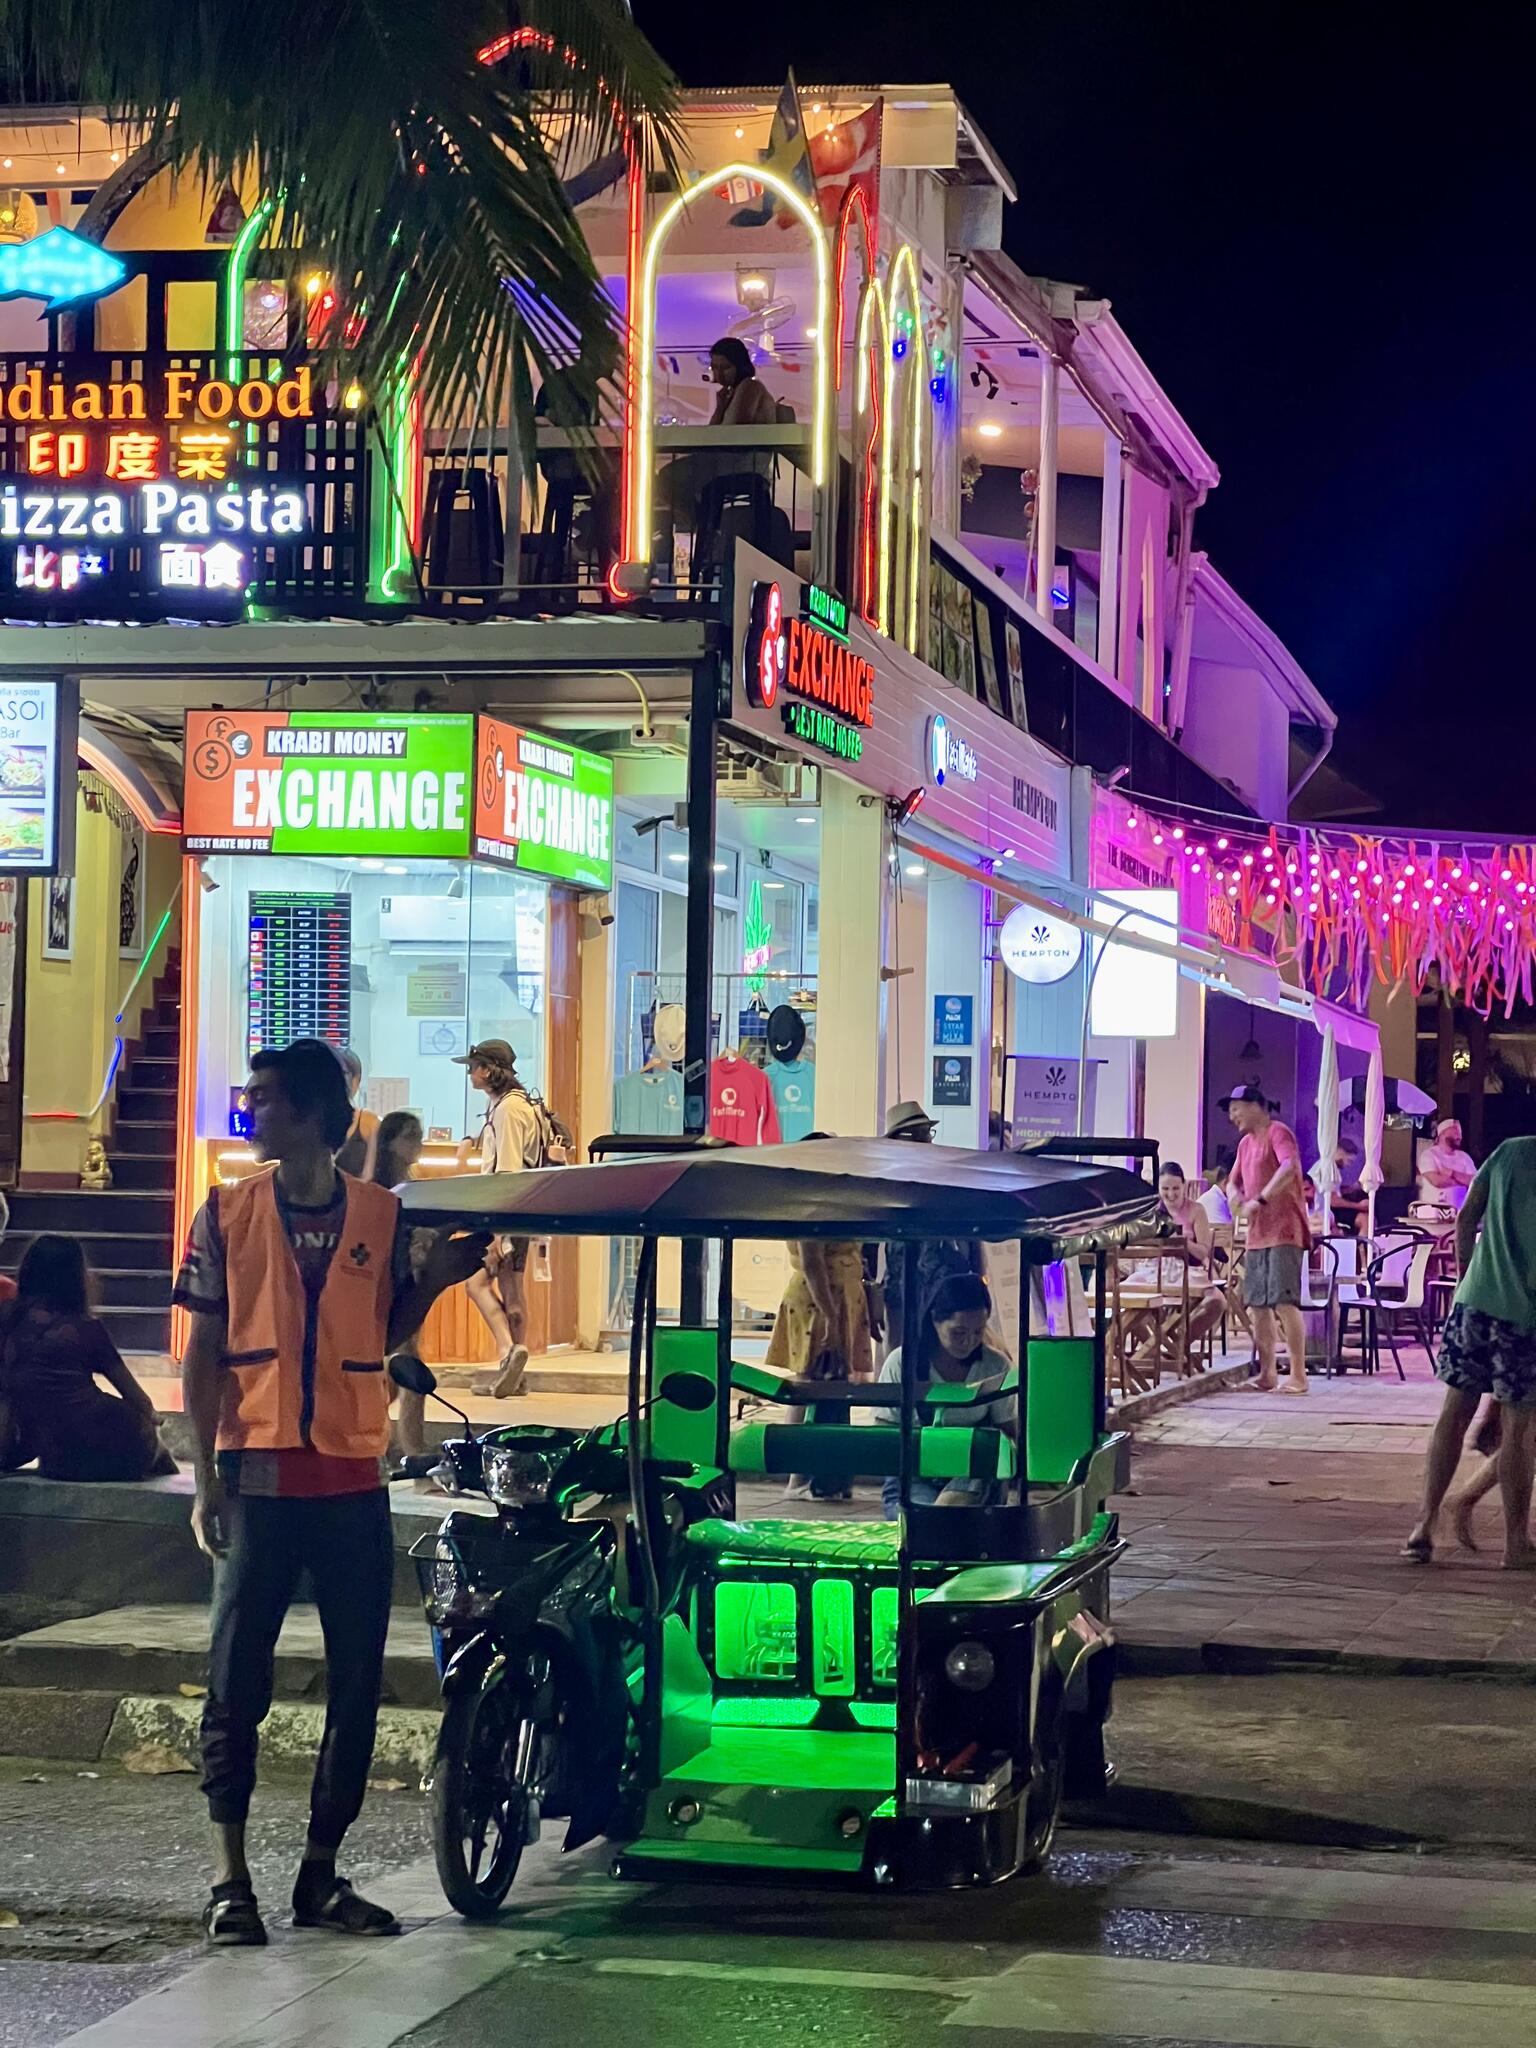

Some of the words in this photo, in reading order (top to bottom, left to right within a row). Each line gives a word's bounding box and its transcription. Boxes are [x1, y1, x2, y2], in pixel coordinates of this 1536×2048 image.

[0, 370, 146, 420] dian
[165, 367, 312, 419] Food
[143, 484, 303, 533] Pasta
[788, 618, 875, 726] EXCHANGE
[0, 700, 44, 720] SOI
[267, 731, 329, 753] KRABI
[335, 732, 406, 754] MONEY
[817, 711, 835, 749] RATE
[836, 723, 846, 757] NO
[233, 769, 464, 830] EXCHANGE
[504, 769, 609, 861] EXCHANGE
[187, 838, 211, 848] BEST
[212, 838, 236, 849] RATE
[237, 839, 251, 849] NO
[252, 839, 269, 849] FEE
[1024, 1091, 1077, 1101] HEMPTO
